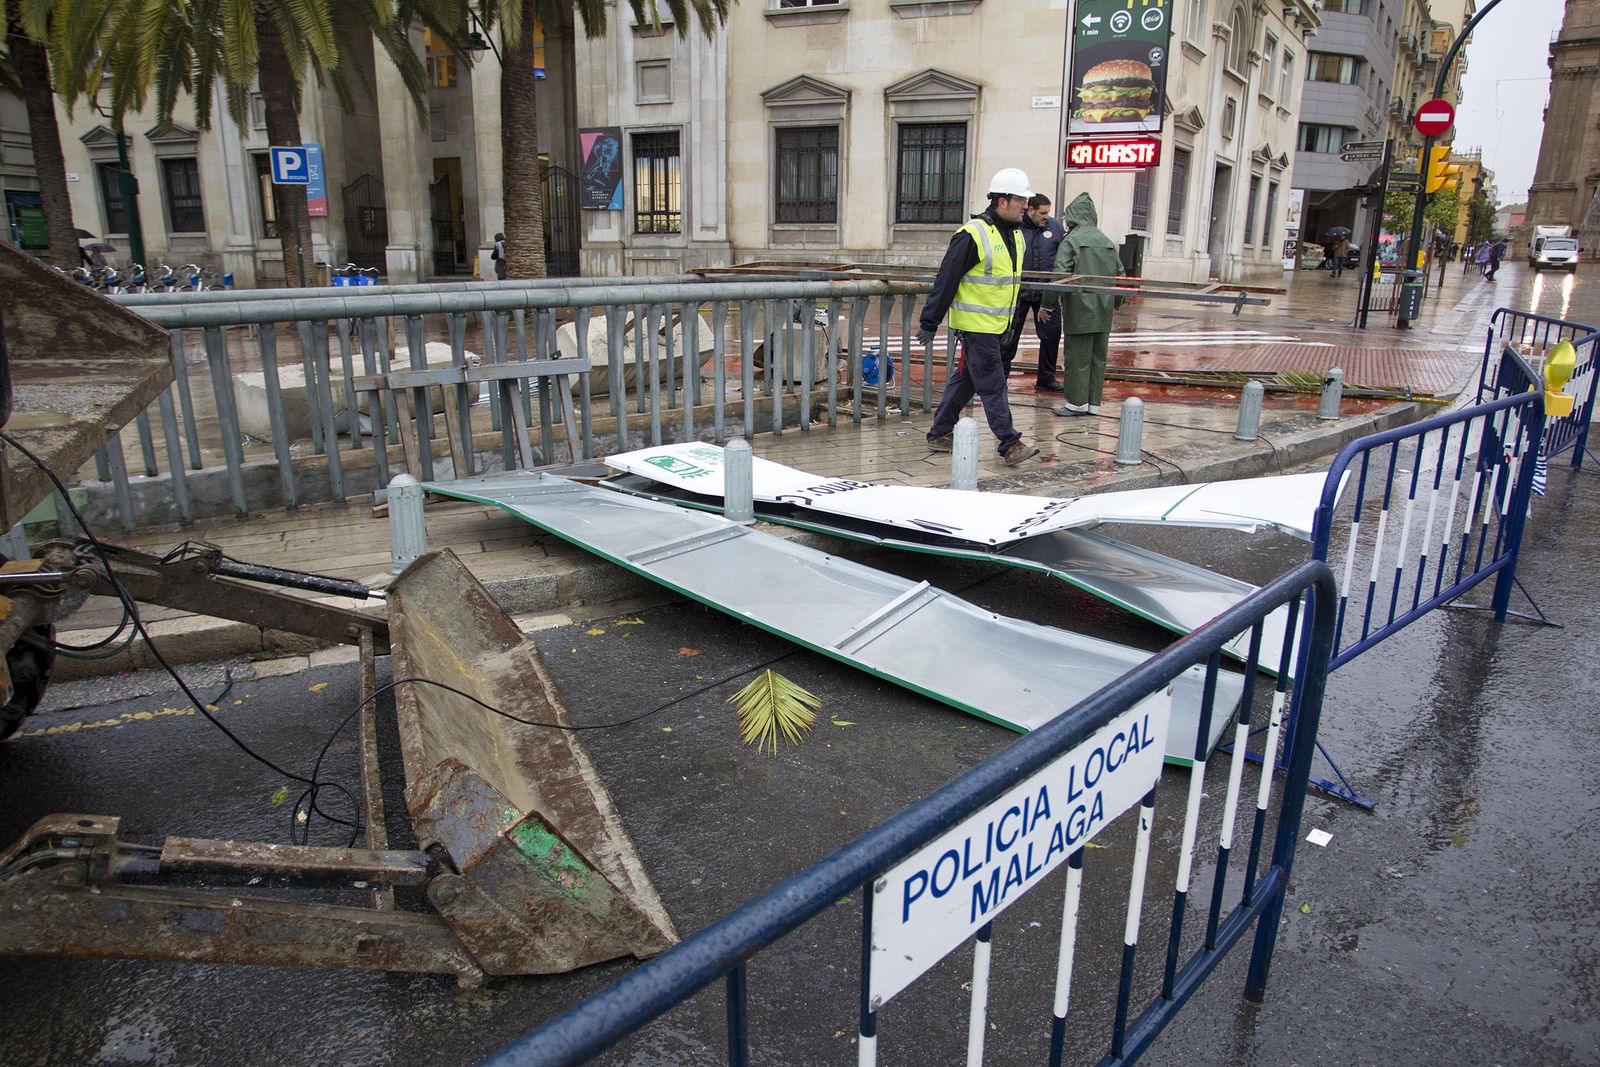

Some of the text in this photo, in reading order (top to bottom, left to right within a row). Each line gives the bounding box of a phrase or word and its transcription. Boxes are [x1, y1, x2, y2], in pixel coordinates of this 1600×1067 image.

[277, 151, 302, 180] P
[902, 713, 1155, 924] POLICIA LOCAL
[969, 790, 1105, 925] MALAGA
